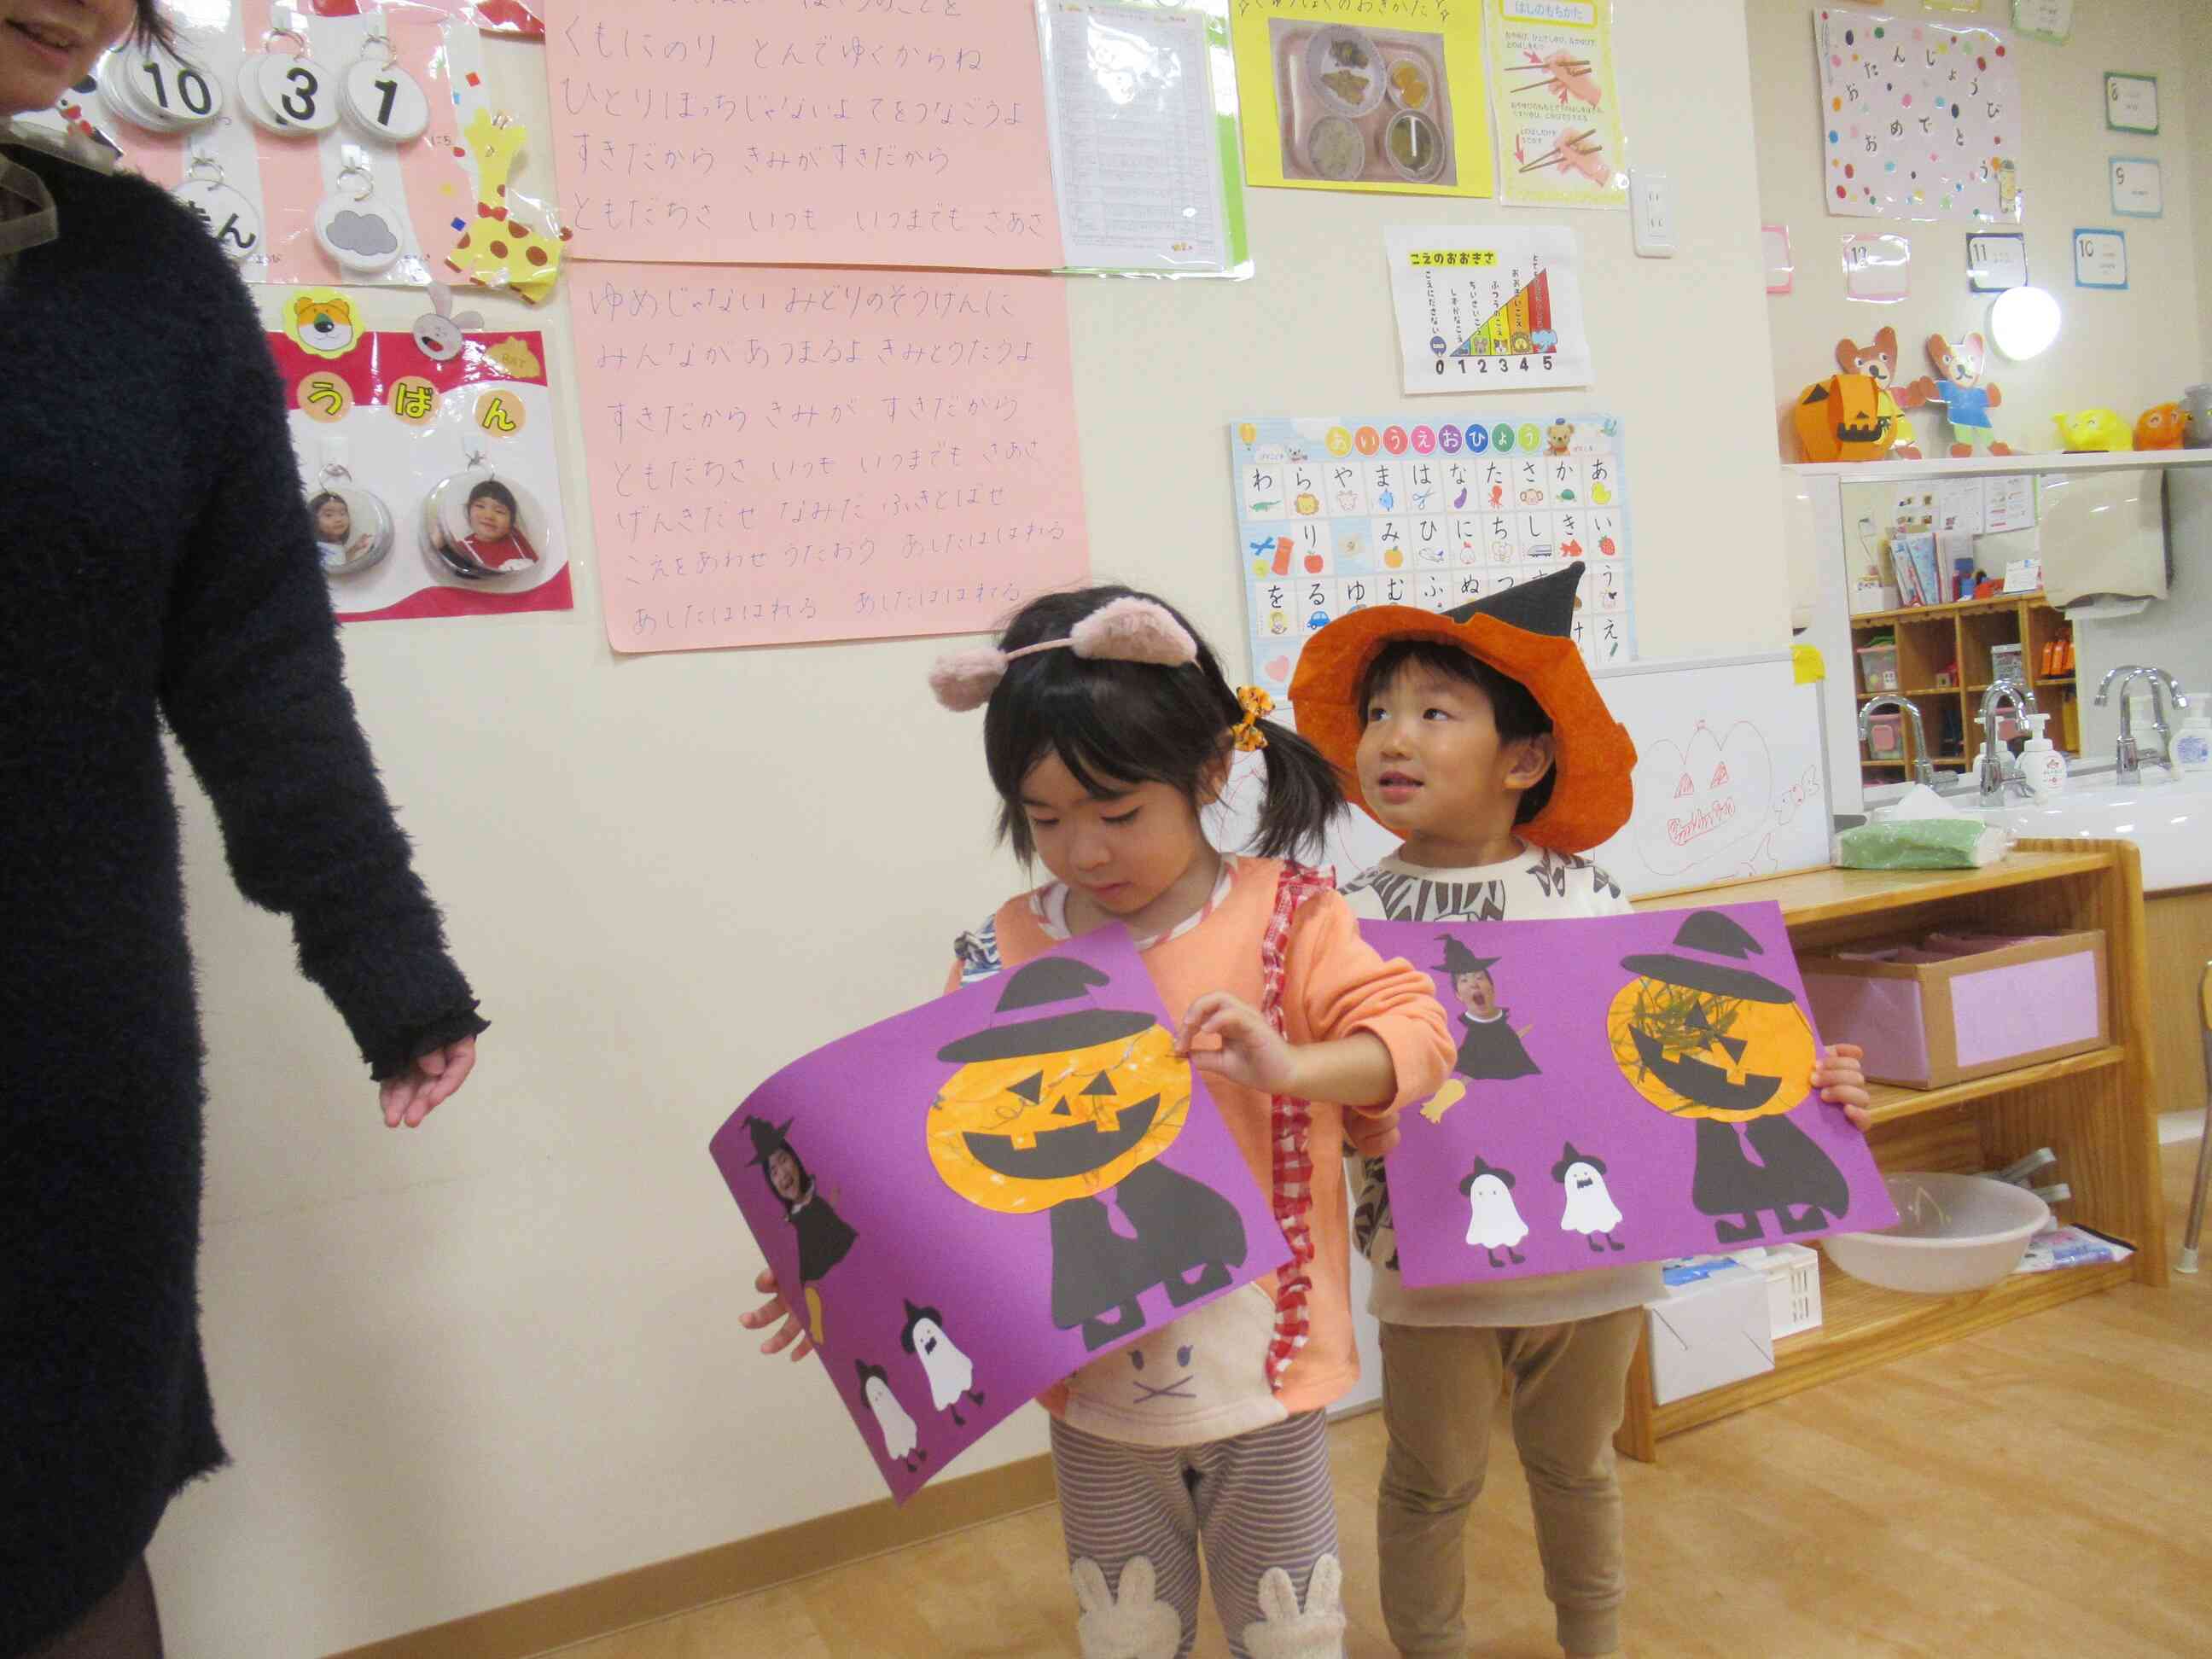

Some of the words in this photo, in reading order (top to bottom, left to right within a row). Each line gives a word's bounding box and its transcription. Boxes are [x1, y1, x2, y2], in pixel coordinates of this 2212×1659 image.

[564, 15, 715, 67] くもにのり
[143, 61, 211, 114] 10
[282, 67, 317, 120] 3
[375, 79, 398, 125] 1
[573, 132, 713, 177] すきだから
[748, 207, 817, 231] いつも
[856, 201, 963, 232] いつまでも
[1410, 252, 1494, 265] こえのおおきさ
[1435, 359, 1445, 375] 0
[1458, 359, 1466, 374] 1
[1477, 358, 1487, 374] 2
[1498, 358, 1509, 372] 3
[1519, 357, 1529, 371] 4
[1542, 355, 1552, 370] 5
[607, 401, 747, 444] すきだから
[881, 395, 1018, 424] すきだから
[1331, 429, 1534, 450] あいうえおひょう
[772, 457, 835, 481] いつも
[860, 440, 961, 474] いつまでも
[1253, 466, 1272, 491] わ
[1296, 465, 1312, 487] ら
[1335, 467, 1353, 488] や
[1376, 465, 1392, 487] ま
[1414, 464, 1431, 485] は
[1451, 463, 1467, 485] な
[1487, 462, 1503, 484] た
[1522, 461, 1536, 482] さ
[1556, 460, 1575, 480] か
[1592, 458, 1608, 480] あ
[1304, 525, 1317, 544] り
[1382, 522, 1400, 542] み
[1420, 521, 1437, 541] ひ
[1457, 520, 1472, 538] に
[1493, 516, 1509, 540] ち
[1528, 515, 1542, 537] し
[1562, 515, 1576, 537] き
[1595, 516, 1612, 532] い
[1267, 584, 1284, 608] を
[1309, 582, 1325, 606] る
[1348, 580, 1365, 603] ゆ
[1387, 578, 1404, 602] む
[1424, 578, 1444, 598] ふ
[1461, 574, 1480, 595] ぬ
[1603, 566, 1612, 585] う
[1604, 620, 1619, 641] え
